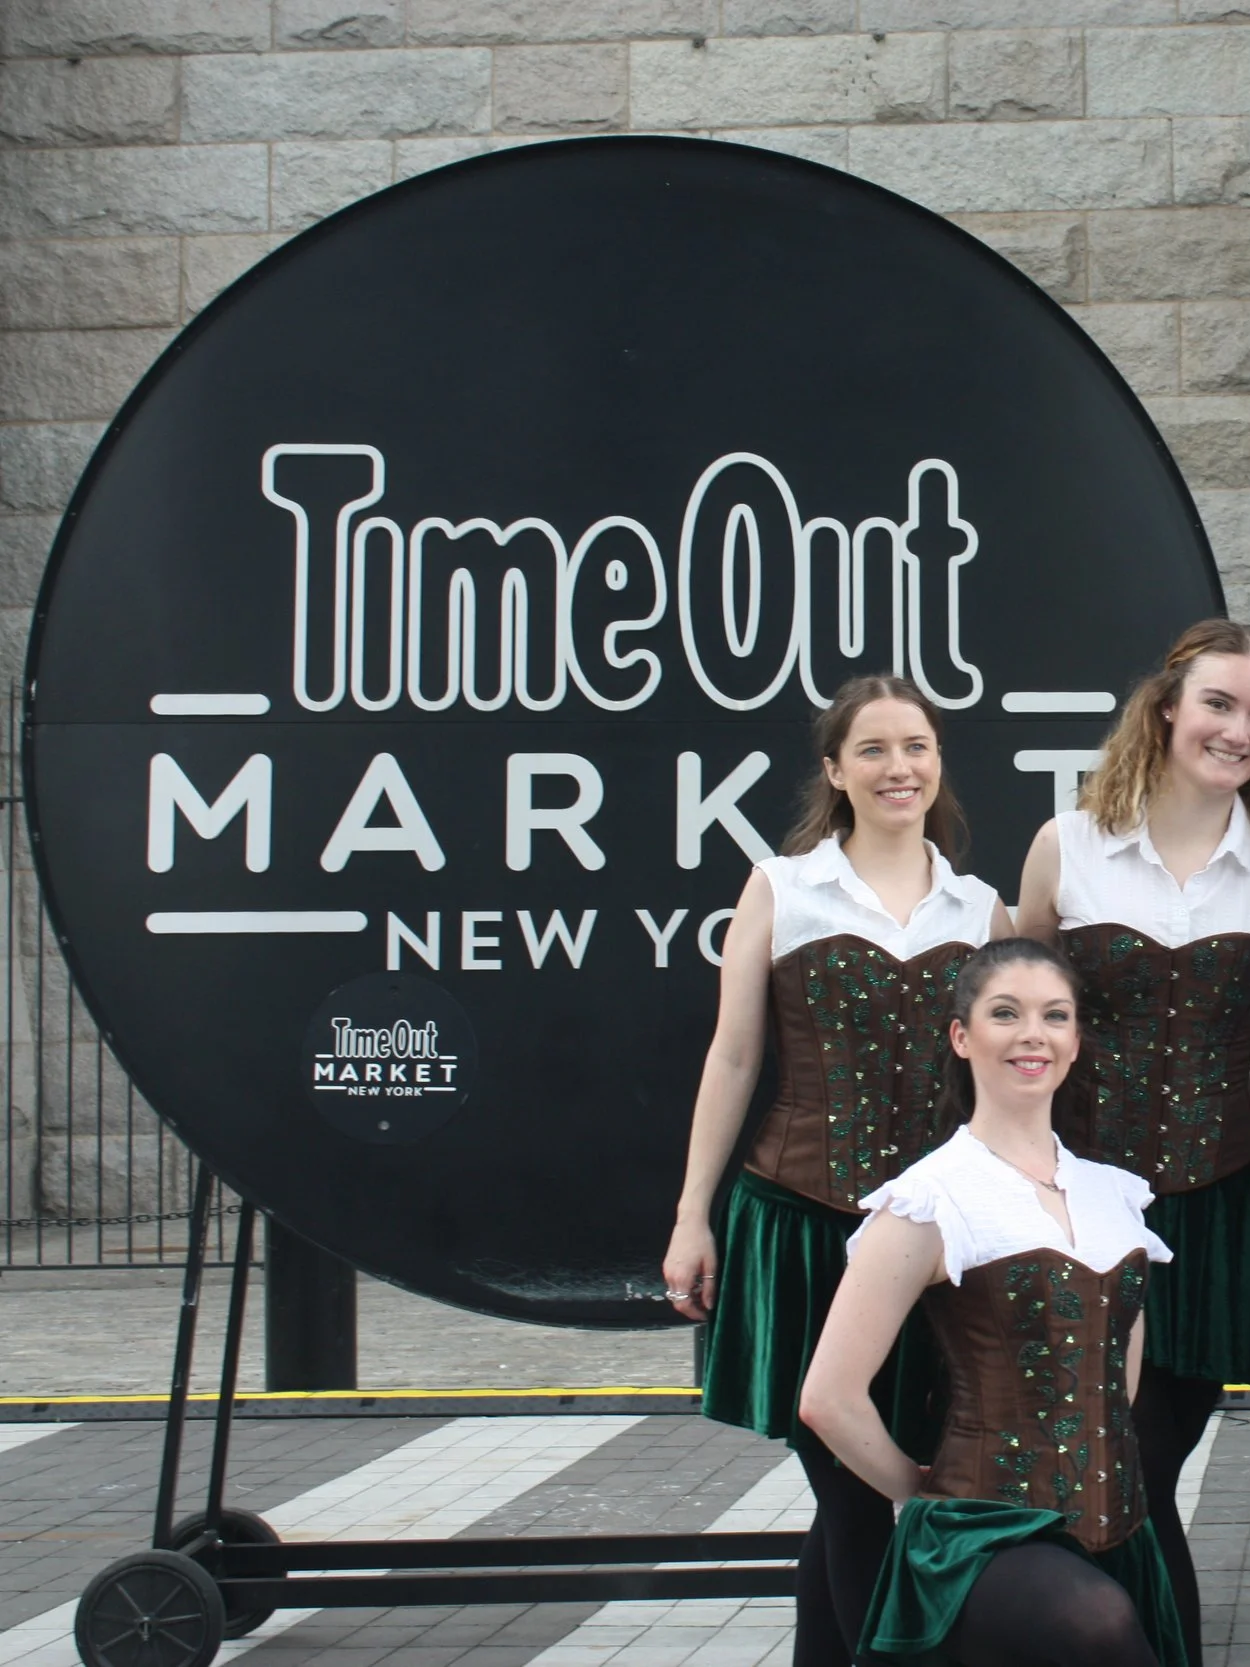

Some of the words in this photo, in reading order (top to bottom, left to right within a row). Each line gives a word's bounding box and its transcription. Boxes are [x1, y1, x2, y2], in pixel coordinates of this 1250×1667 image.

[262, 443, 668, 712] Time
[677, 451, 984, 712] Out
[147, 750, 1108, 873] MARKT
[386, 909, 598, 971] NEW
[634, 907, 738, 969] YO
[331, 1017, 392, 1059] Time
[392, 1019, 438, 1059] Out
[314, 1062, 458, 1083] MARKET
[347, 1086, 381, 1097] NEW
[385, 1086, 423, 1097] YORK
